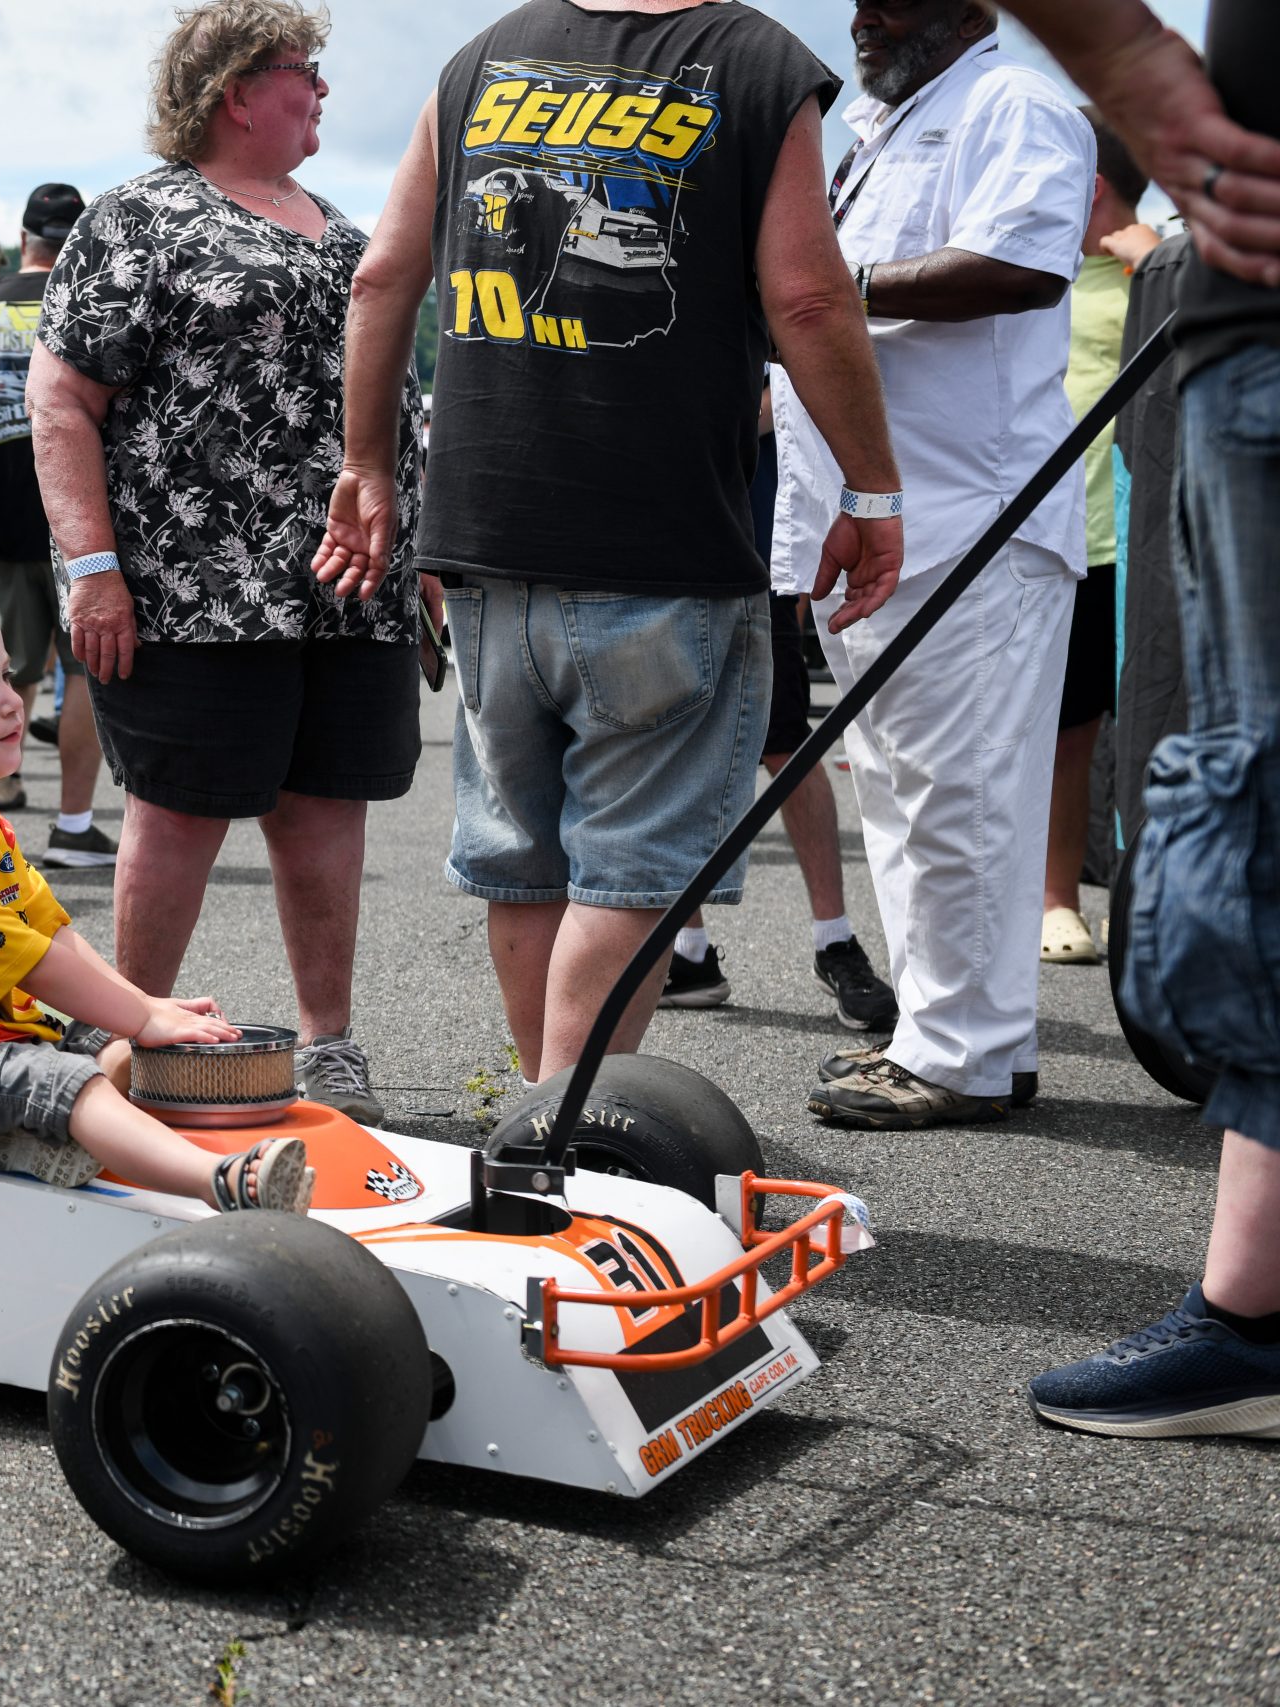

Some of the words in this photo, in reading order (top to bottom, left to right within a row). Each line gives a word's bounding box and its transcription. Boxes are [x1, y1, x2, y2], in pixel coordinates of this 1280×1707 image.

[463, 80, 714, 161] SEUSS
[533, 80, 709, 105] ANDY
[531, 313, 588, 350] NH
[530, 1103, 636, 1142] Hsier
[580, 1230, 669, 1322] 31
[55, 1285, 135, 1402] Hoosier
[638, 1428, 683, 1477] GRM
[675, 1379, 754, 1451] TRUCKING
[748, 1372, 771, 1395] CAPE
[767, 1362, 789, 1381] COD,
[783, 1352, 799, 1369] MA
